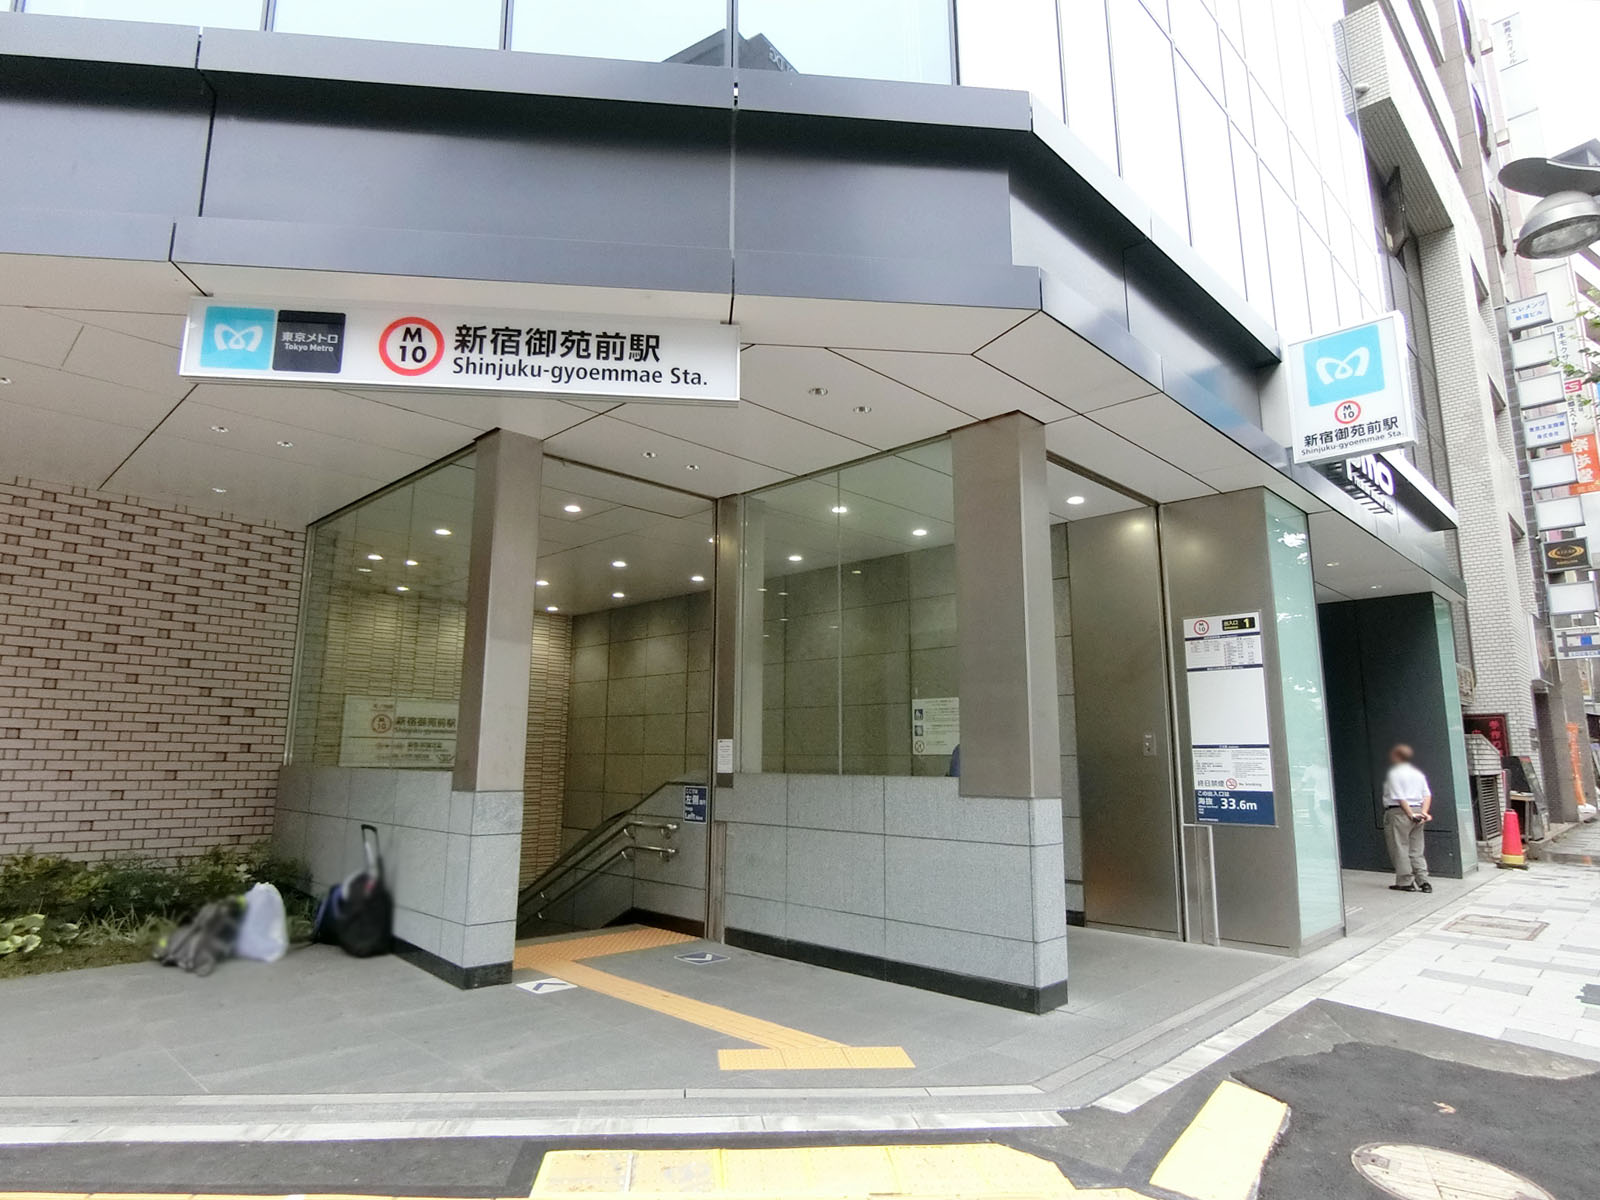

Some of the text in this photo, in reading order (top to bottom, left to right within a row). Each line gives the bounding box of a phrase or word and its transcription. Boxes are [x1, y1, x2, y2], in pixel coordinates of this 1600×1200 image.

[281, 331, 339, 344] 東京メトロ
[402, 326, 423, 343] M
[453, 323, 660, 363] 新宿御苑前駅
[284, 342, 334, 353] Tokyo Metro
[399, 345, 427, 363] 10
[452, 357, 708, 386] Shinjuku-gyoemmae Sta.
[1343, 411, 1355, 419] 10
[1303, 416, 1399, 448] 新宿御苑前駅
[1301, 434, 1385, 456] Shinjuku-gyoemmae
[1243, 618, 1250, 629] 1
[1219, 797, 1258, 810] 33.6m
